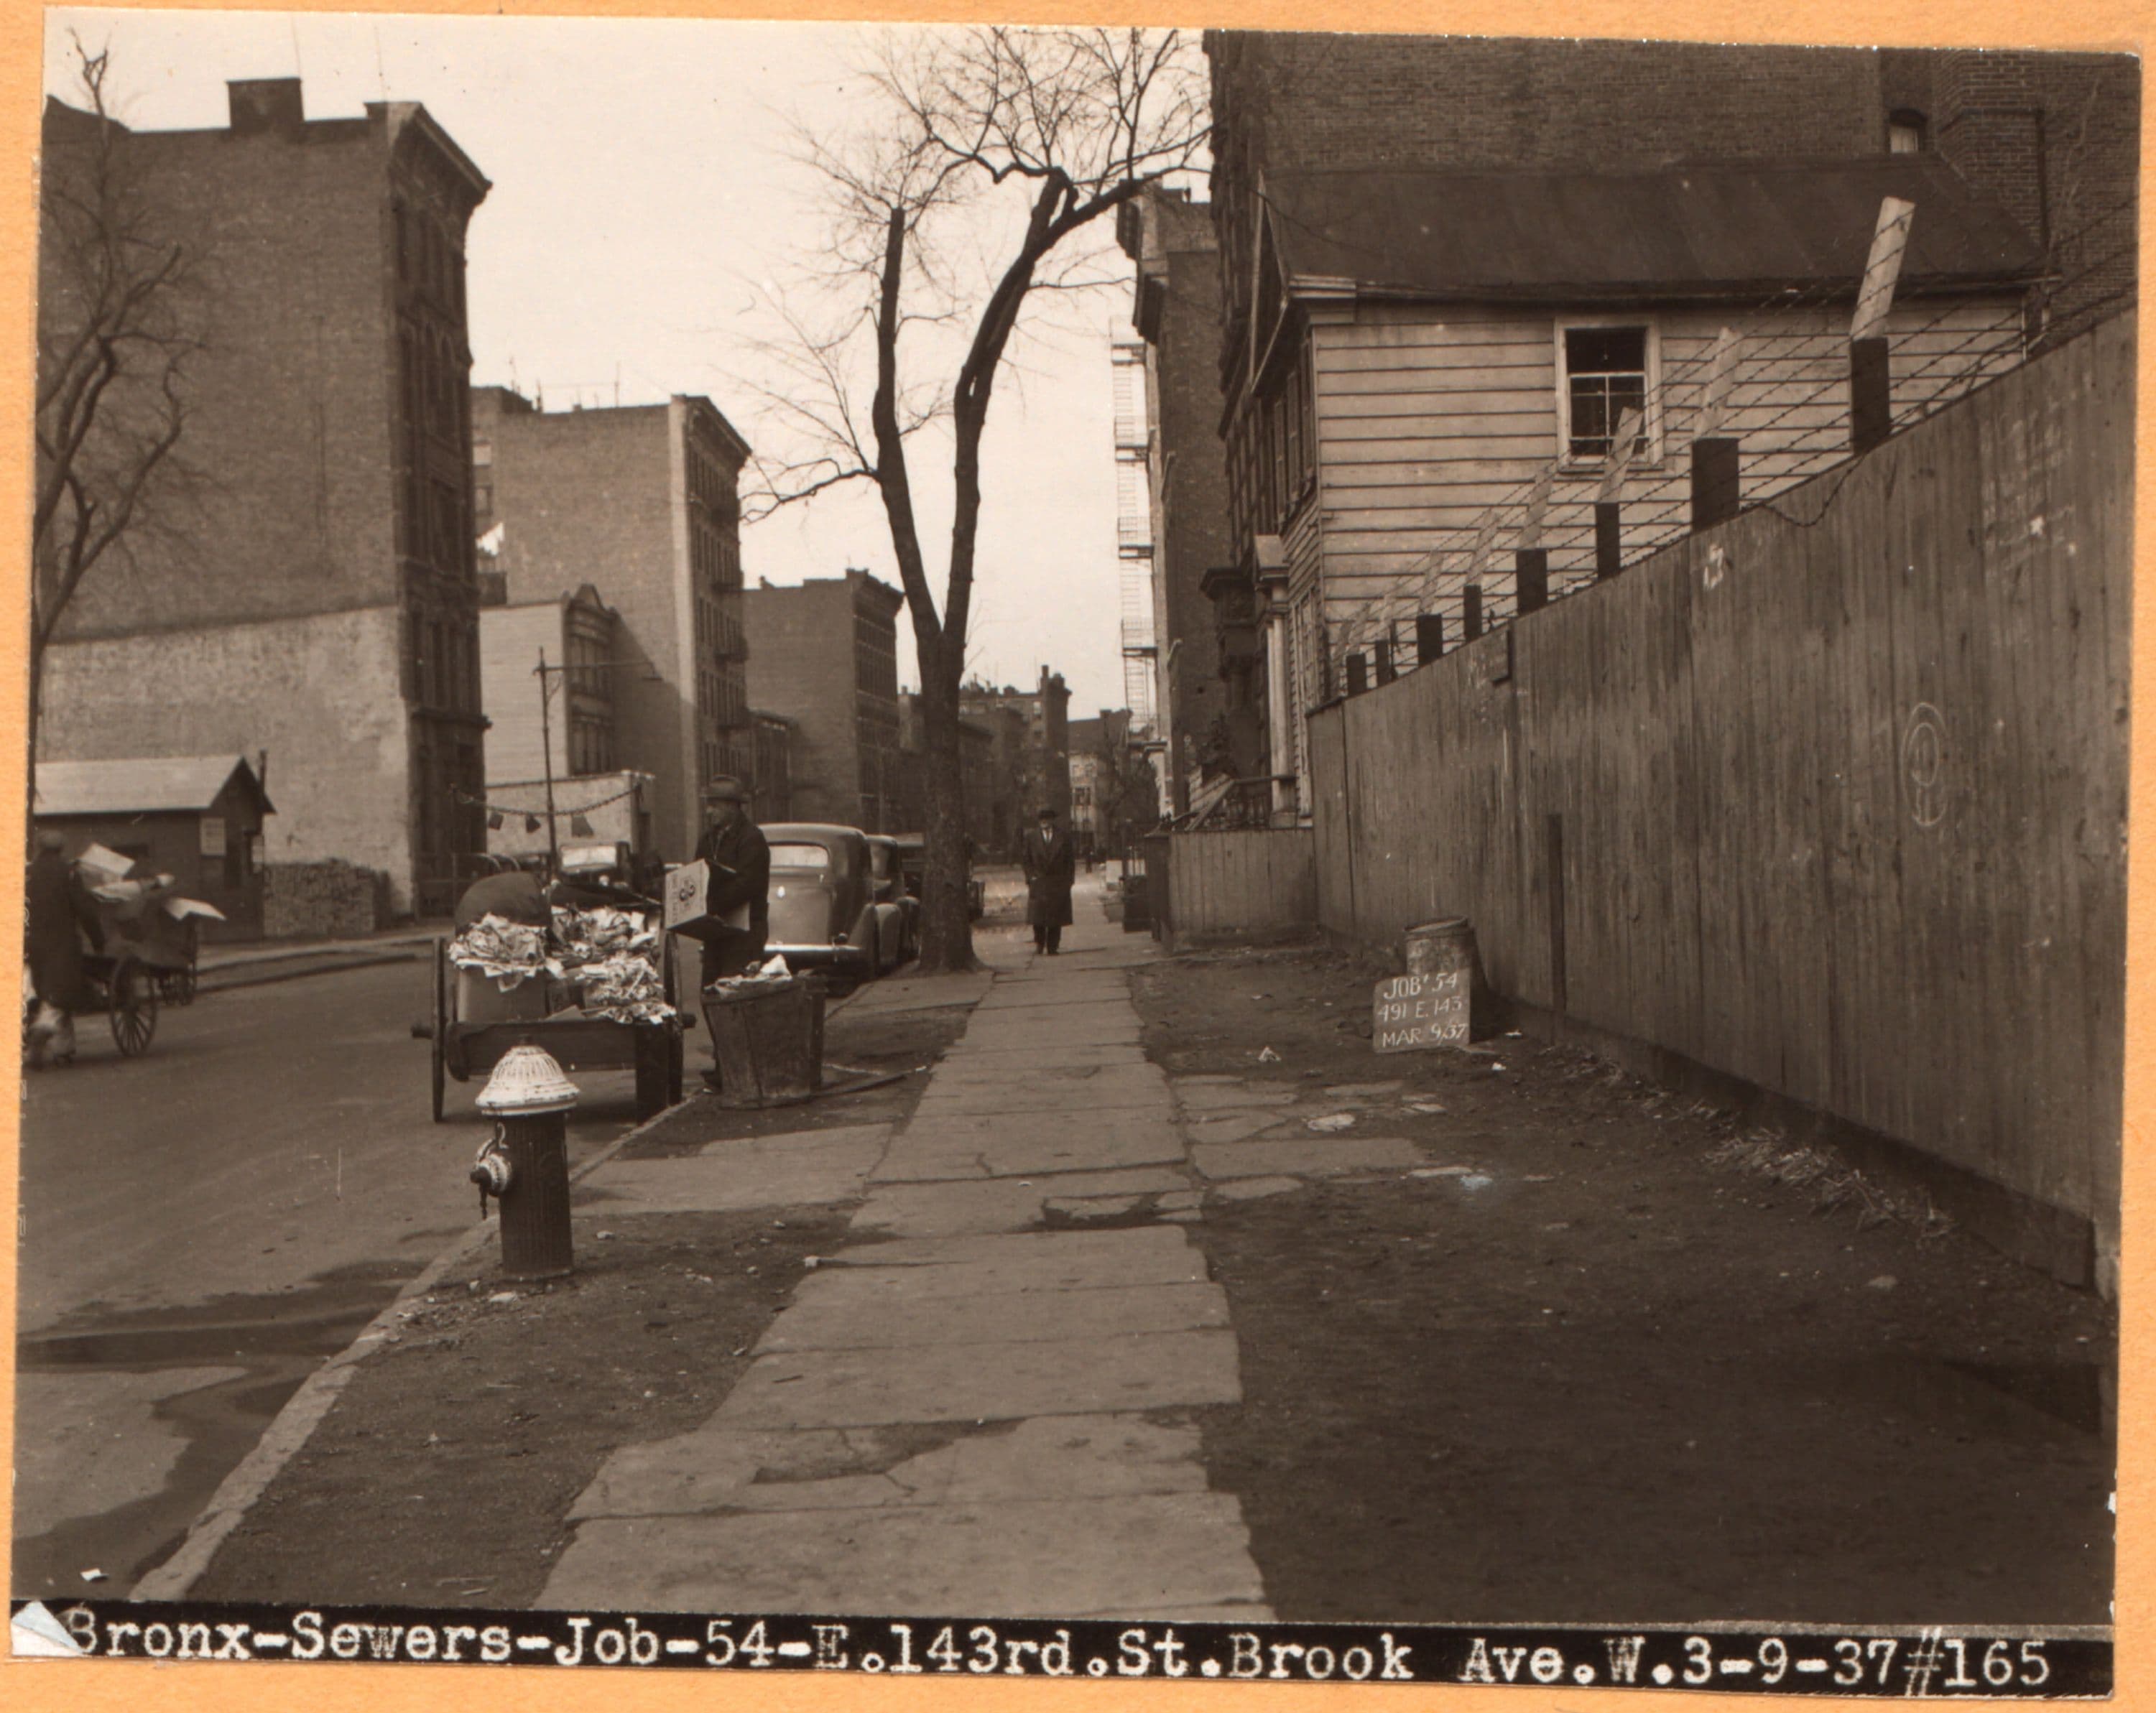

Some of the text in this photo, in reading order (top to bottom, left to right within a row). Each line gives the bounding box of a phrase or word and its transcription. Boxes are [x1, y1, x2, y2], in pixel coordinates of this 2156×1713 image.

[1431, 972, 1458, 993] 54
[1377, 1003, 1407, 1023] 491
[1382, 1028, 1422, 1048] MAR
